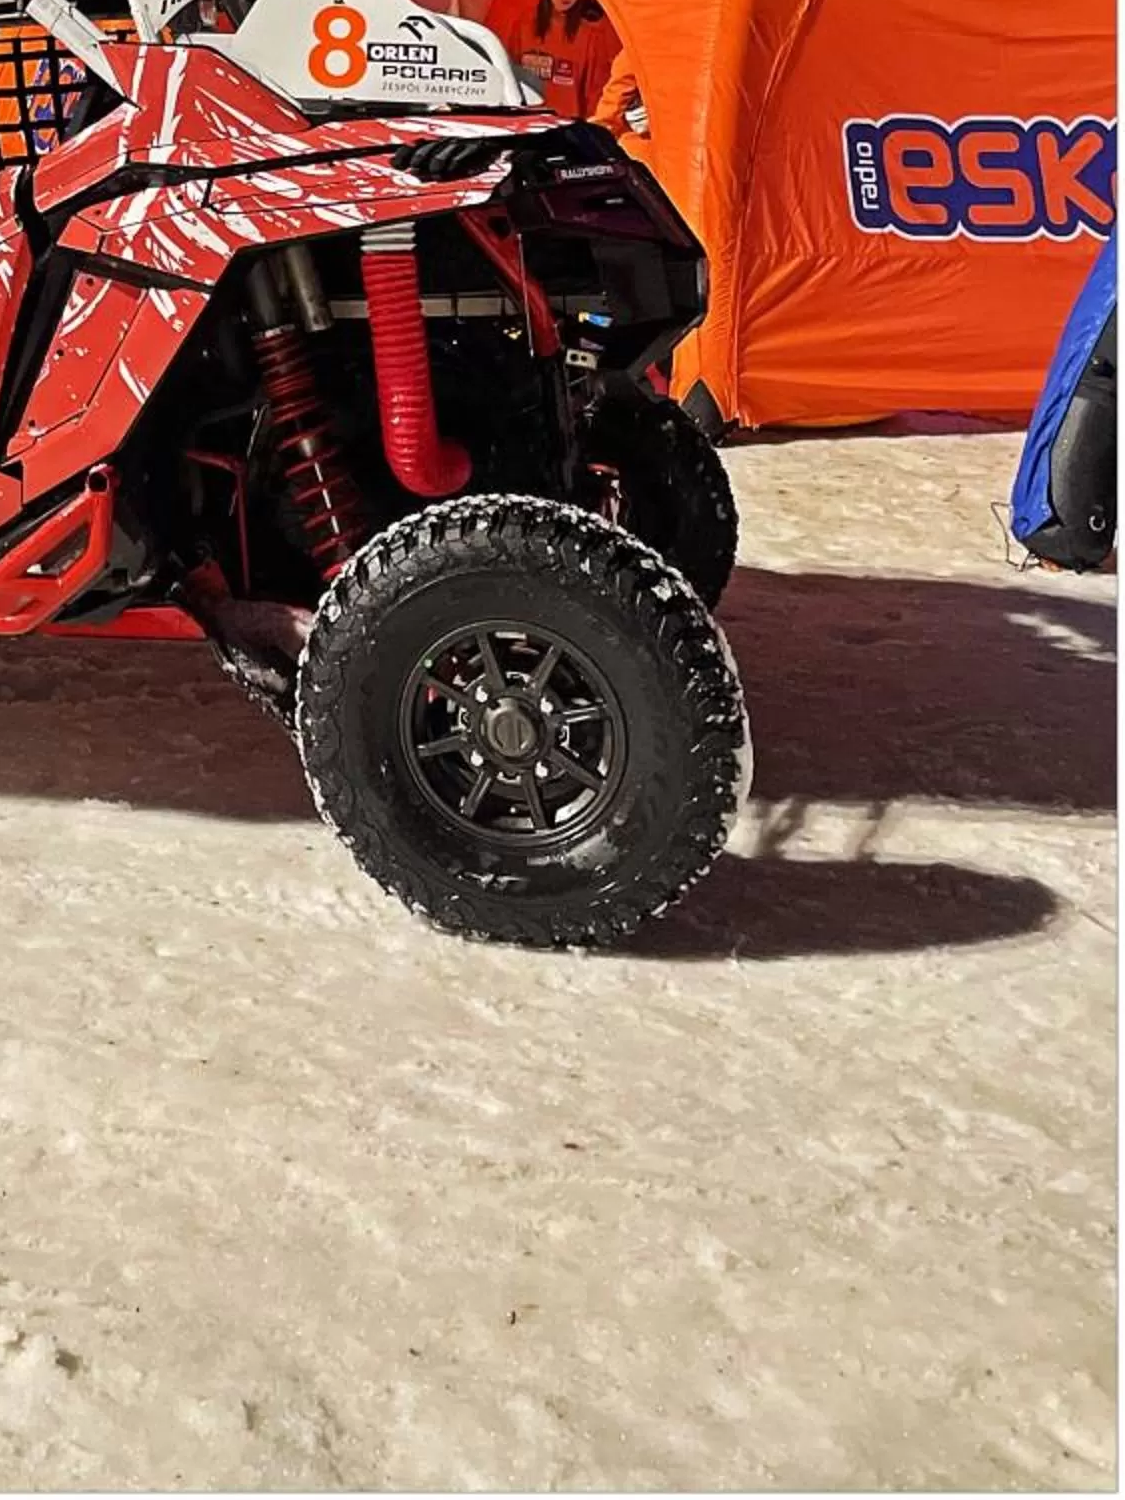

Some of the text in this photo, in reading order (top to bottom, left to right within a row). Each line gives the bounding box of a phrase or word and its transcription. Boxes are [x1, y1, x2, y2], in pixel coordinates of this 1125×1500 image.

[308, 6, 367, 89] 8
[370, 46, 434, 62] ORLEN
[382, 65, 487, 83] POLARIS
[853, 130, 1116, 225] radio esk
